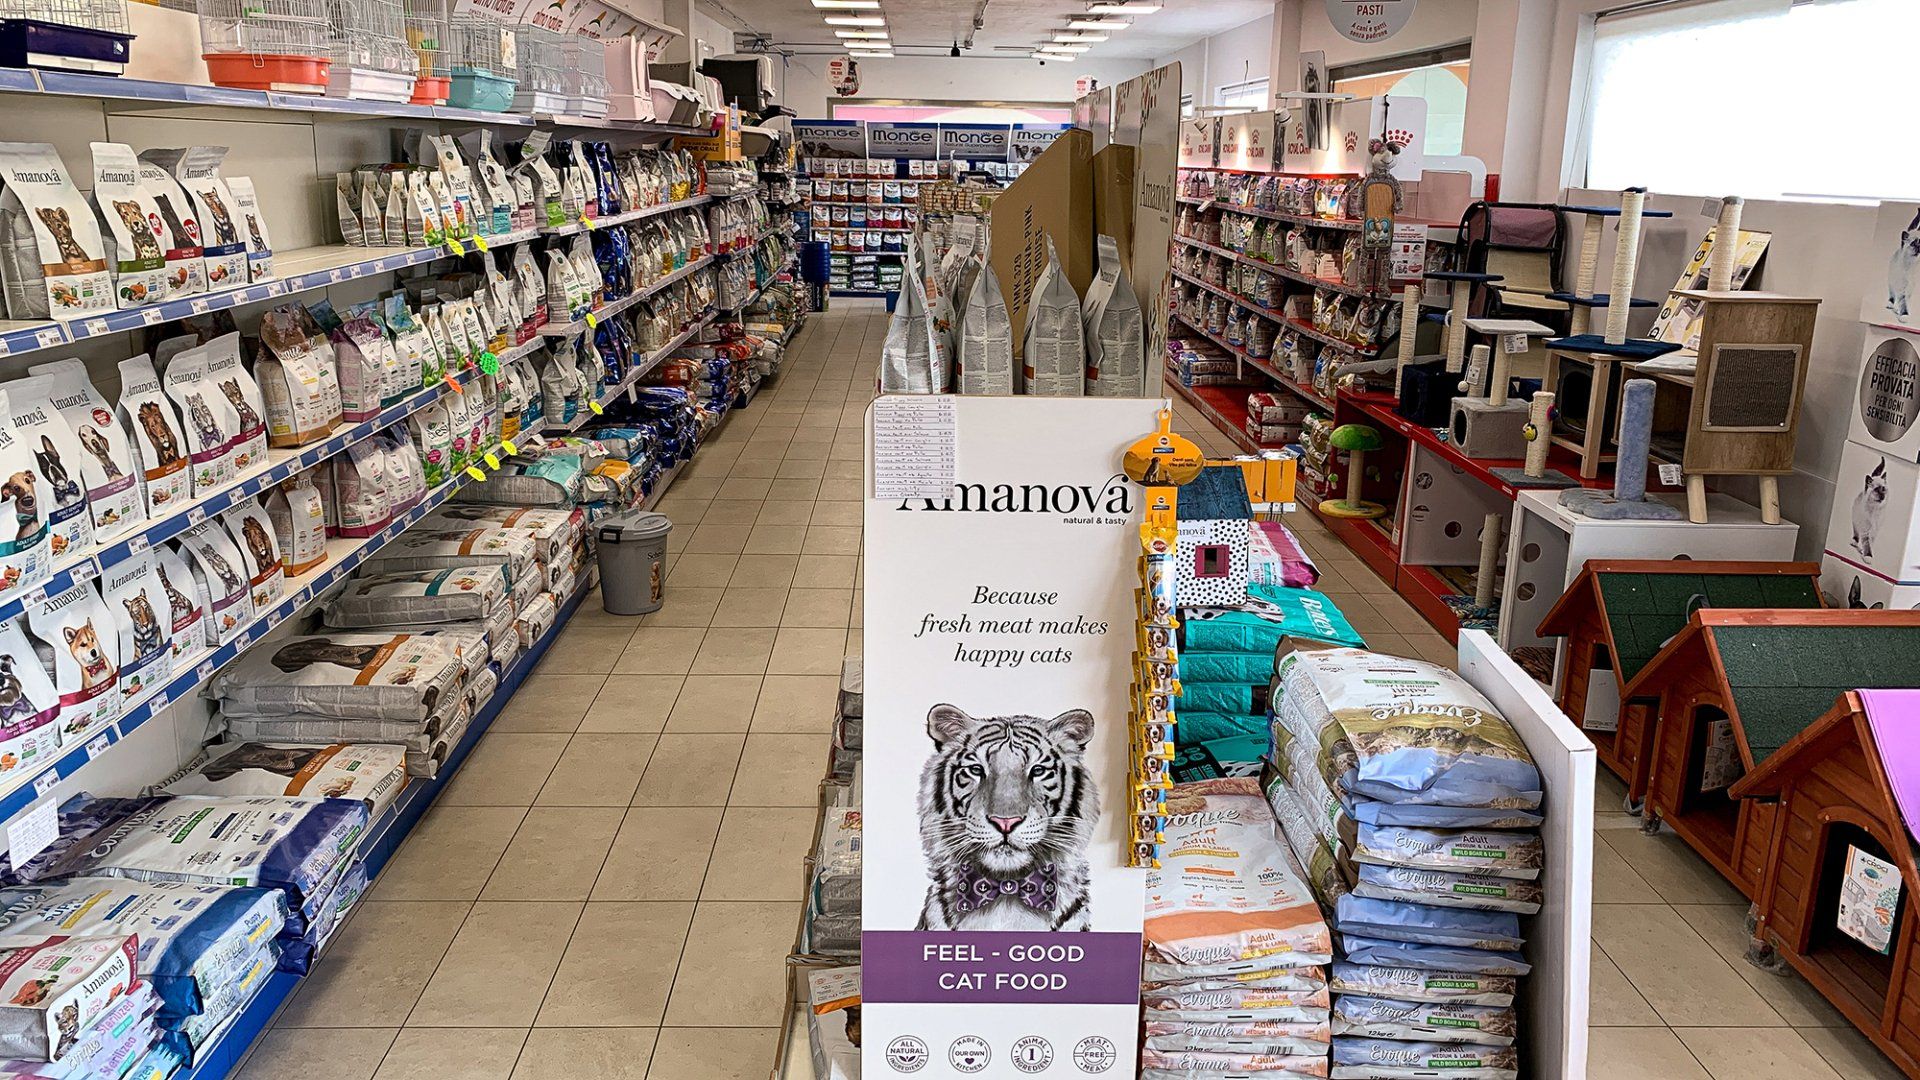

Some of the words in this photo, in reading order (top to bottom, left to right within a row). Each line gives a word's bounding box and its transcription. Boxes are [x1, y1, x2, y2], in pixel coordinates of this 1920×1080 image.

[1356, 4, 1384, 16] PASTI
[1374, 21, 1387, 32] gatti
[1349, 30, 1365, 39] senza
[1366, 29, 1388, 40] padrone
[1023, 204, 1033, 305] AMANOVA-PINK
[1034, 226, 1044, 271] HOUSE
[1013, 280, 1023, 315] VIMK
[1875, 355, 1917, 380] EFFICACIA
[1870, 372, 1915, 400] PROVATA
[1874, 395, 1888, 408] PER
[1887, 397, 1905, 412] OGNI
[1063, 516, 1094, 525] natural
[1096, 517, 1103, 525] &
[1105, 517, 1127, 526] tasty
[972, 585, 1058, 605] Because
[914, 613, 972, 638] fresh
[978, 617, 1033, 635] meat
[1038, 615, 1109, 636] makes
[953, 643, 1024, 668] happy
[1030, 645, 1073, 663] cats
[1182, 836, 1217, 846] Adult
[1463, 835, 1489, 844] Adult
[1257, 871, 1284, 880] 100%
[1250, 933, 1276, 944] Adult
[923, 945, 984, 962] FEEL
[1009, 945, 1085, 963] GOOD
[938, 973, 987, 990] CAT
[995, 973, 1067, 990] FOOD
[956, 1037, 976, 1047] MADE
[976, 1039, 984, 1047] IN
[1018, 1037, 1047, 1049] ANIMAL
[1083, 1037, 1107, 1046] MEAT
[1028, 1048, 1035, 1061] 1
[1251, 1055, 1276, 1064] Adult
[889, 1057, 925, 1071] INGREDIENTS
[955, 1062, 983, 1072] KITCHEN
[1014, 1055, 1051, 1071] INGREDIENT
[1083, 1064, 1107, 1072] MEAL
